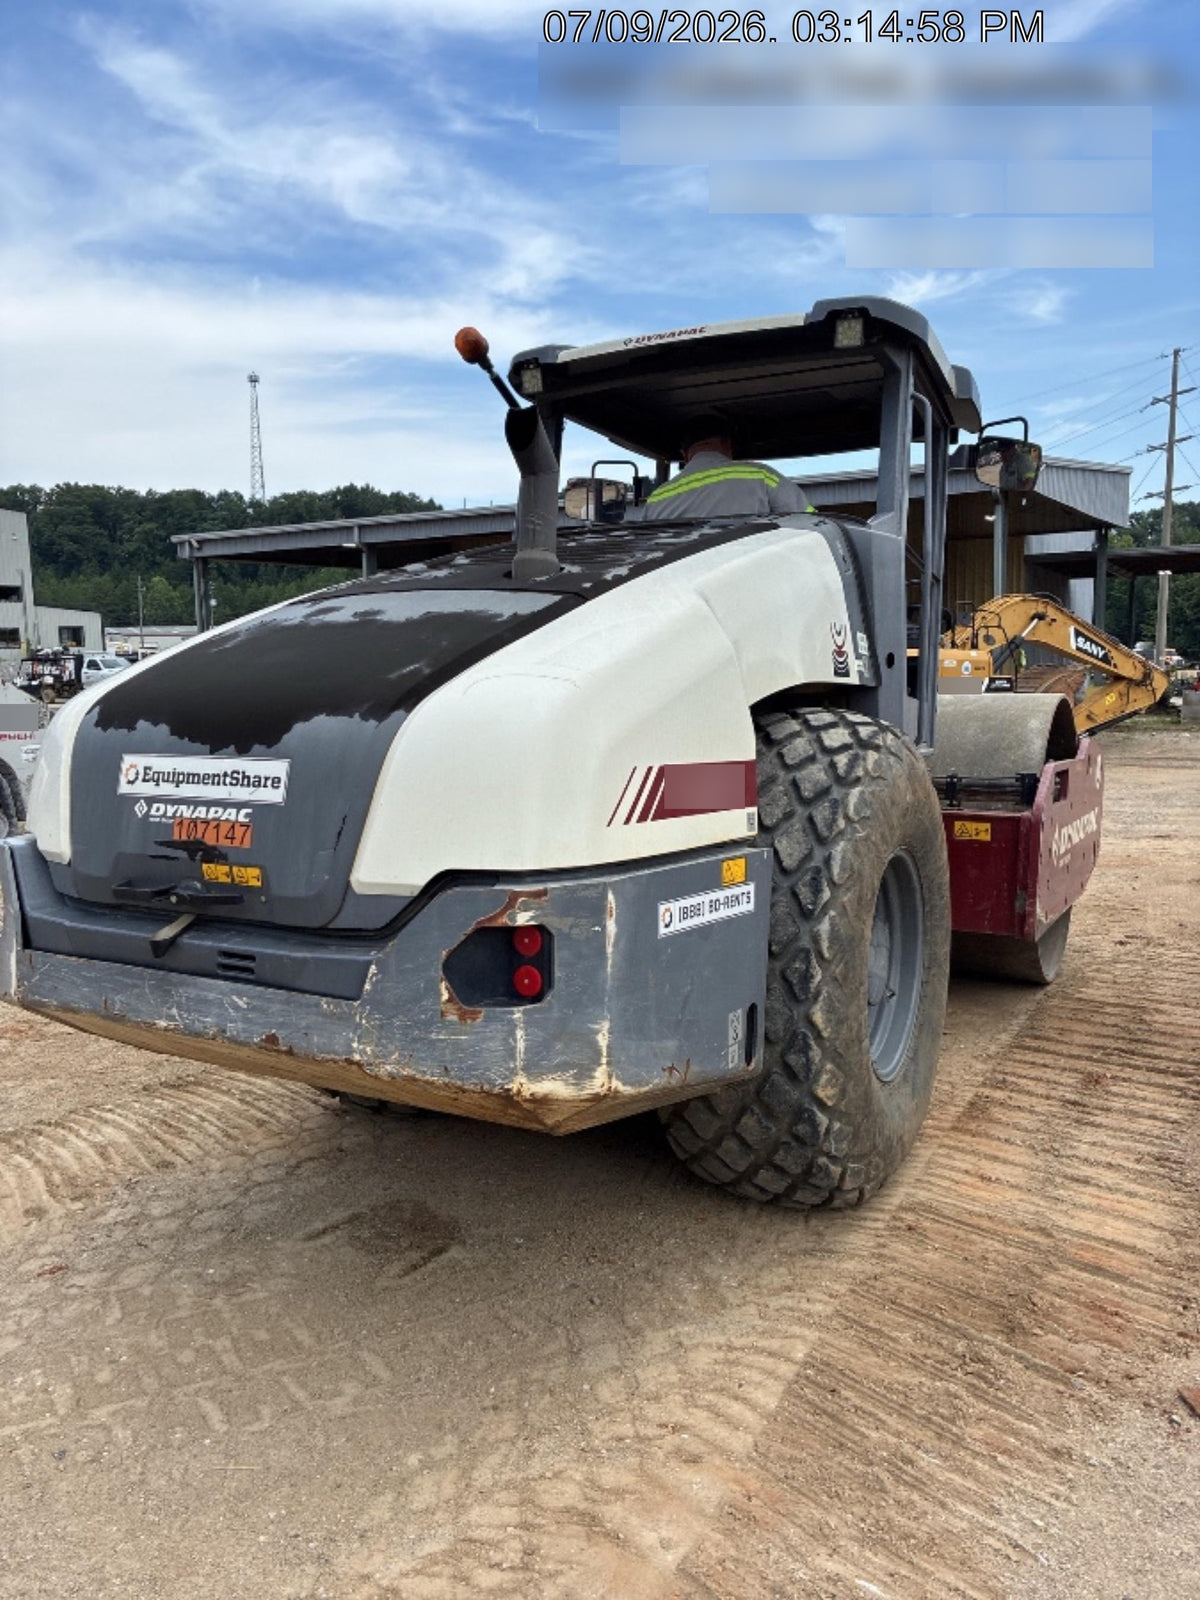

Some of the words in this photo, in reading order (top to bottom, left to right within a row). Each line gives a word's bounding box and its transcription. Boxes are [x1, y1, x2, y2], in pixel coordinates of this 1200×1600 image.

[1077, 636, 1107, 658] SANY
[142, 766, 282, 789] EquipmentShare
[150, 802, 253, 822] DYNAPAC
[175, 819, 250, 845] 107147
